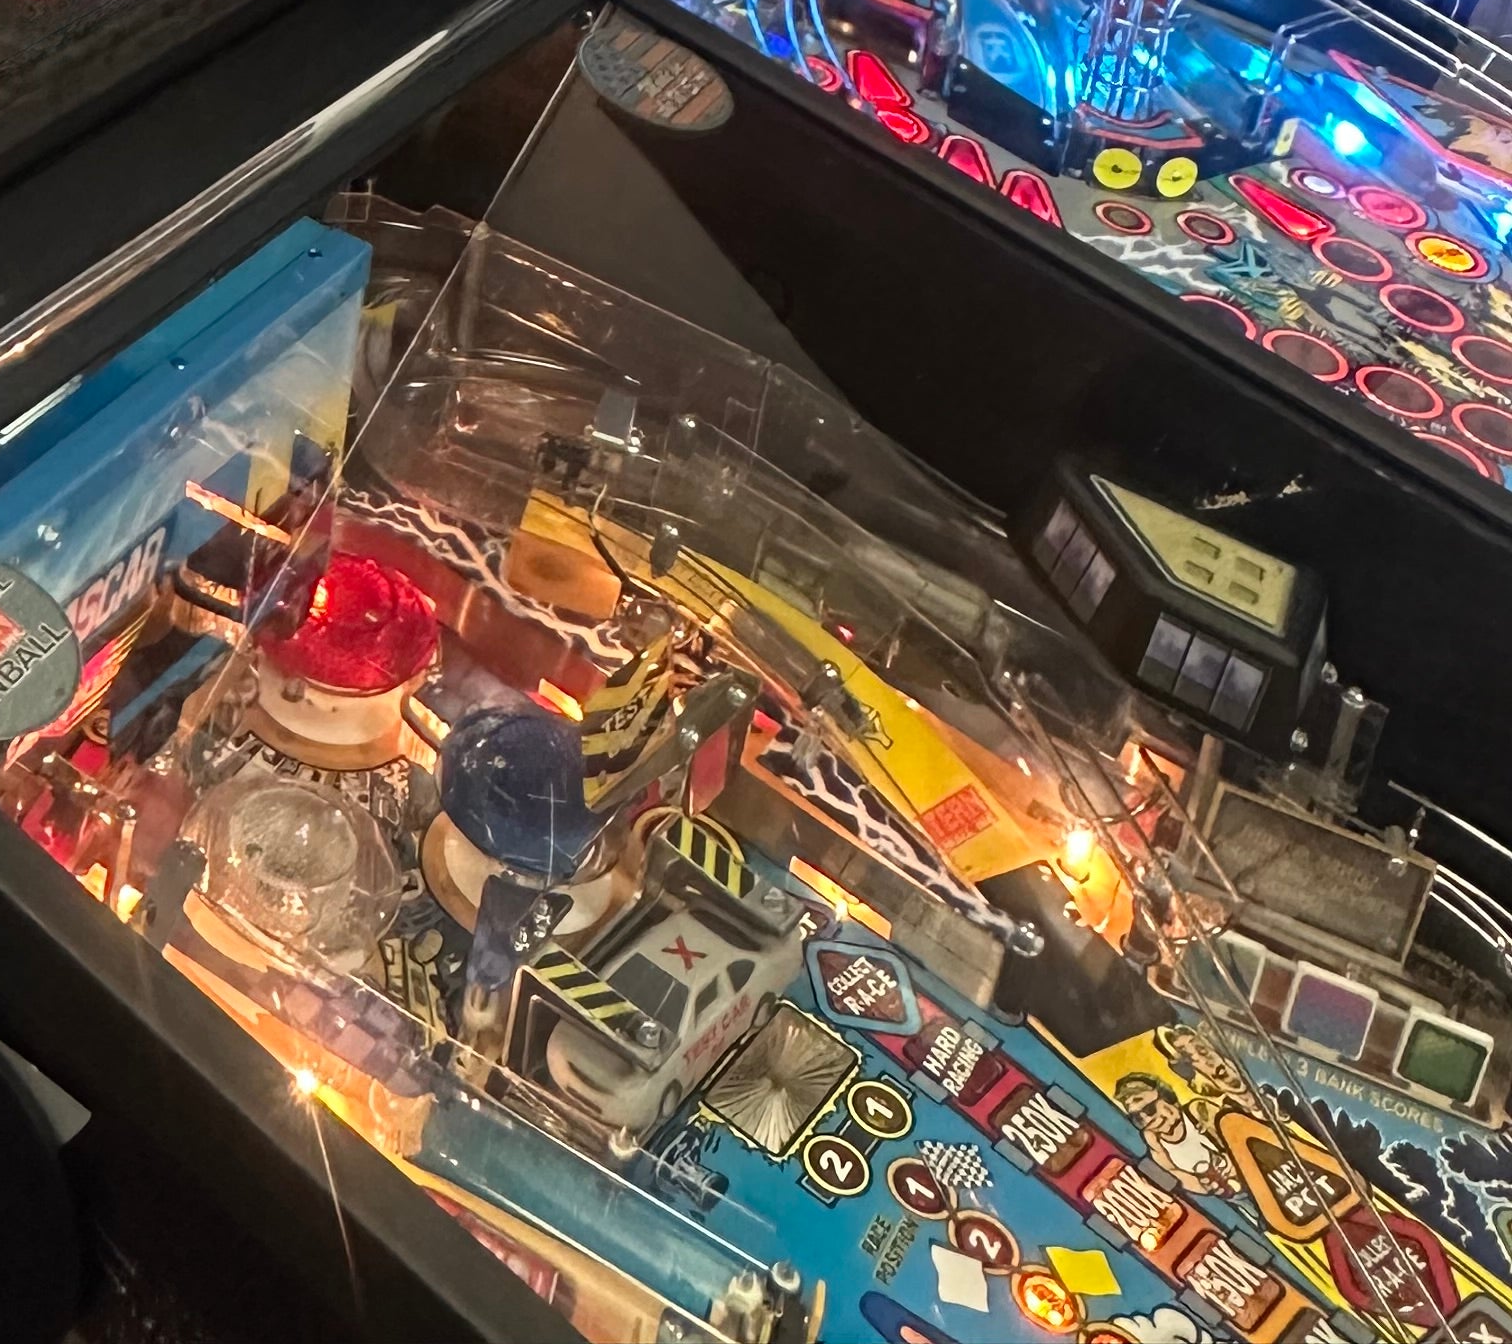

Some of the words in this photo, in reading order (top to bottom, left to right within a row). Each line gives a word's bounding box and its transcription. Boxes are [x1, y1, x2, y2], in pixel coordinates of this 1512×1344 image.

[922, 1025, 962, 1077] HARD
[942, 1037, 984, 1097] RACING
[867, 1095, 894, 1121] 1
[1001, 1092, 1080, 1165] 250K
[1369, 1090, 1445, 1134] SCORES
[831, 1147, 854, 1182] 2
[1267, 1159, 1320, 1197] JAC
[905, 1176, 936, 1201] 1
[1093, 1164, 1175, 1243] 200K
[860, 1214, 893, 1257] RACE
[874, 1216, 920, 1286] POSITION
[968, 1228, 1003, 1260] 2
